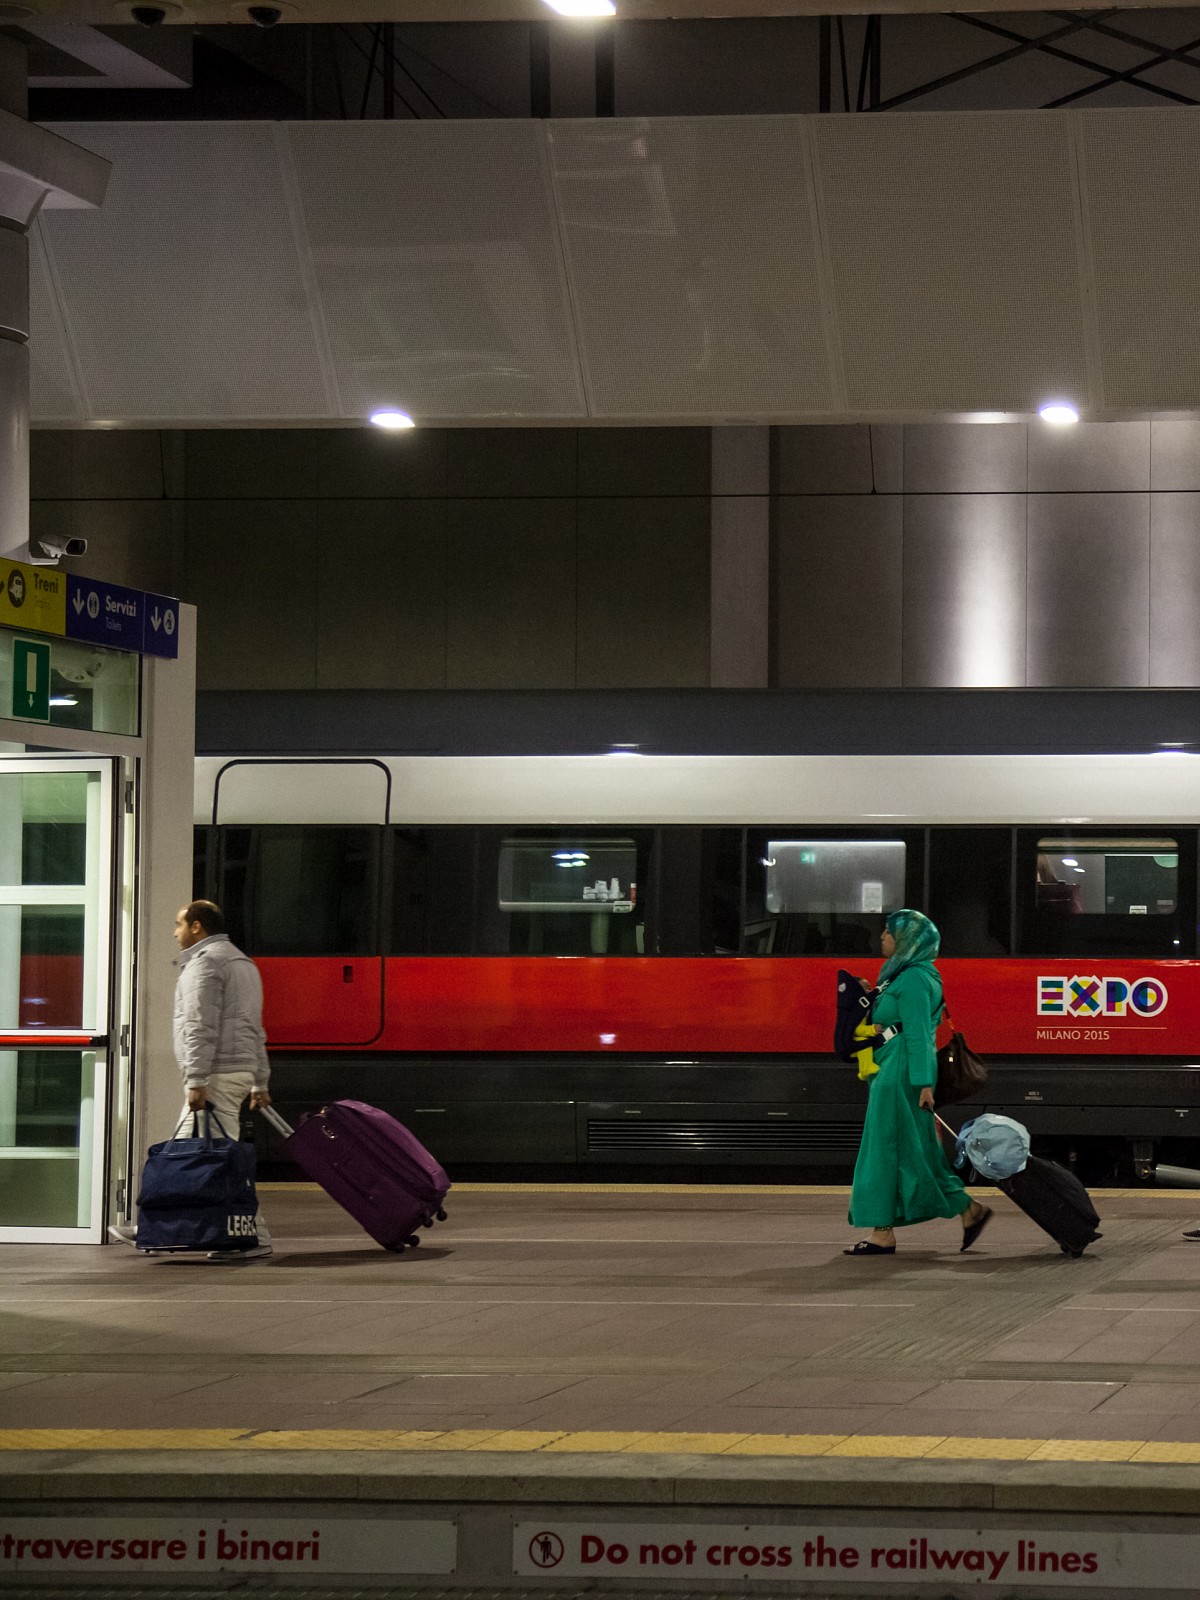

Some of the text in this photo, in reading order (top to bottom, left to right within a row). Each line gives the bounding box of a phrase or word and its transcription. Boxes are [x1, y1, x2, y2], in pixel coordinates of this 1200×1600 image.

[33, 572, 59, 594] Treni
[105, 595, 137, 617] Servizi
[1036, 975, 1168, 1018] EXPO
[1036, 1030, 1110, 1040] MILANO 2015
[0, 1529, 320, 1560] traversare i binari
[581, 1535, 1098, 1580] Do not cross the railway lines
